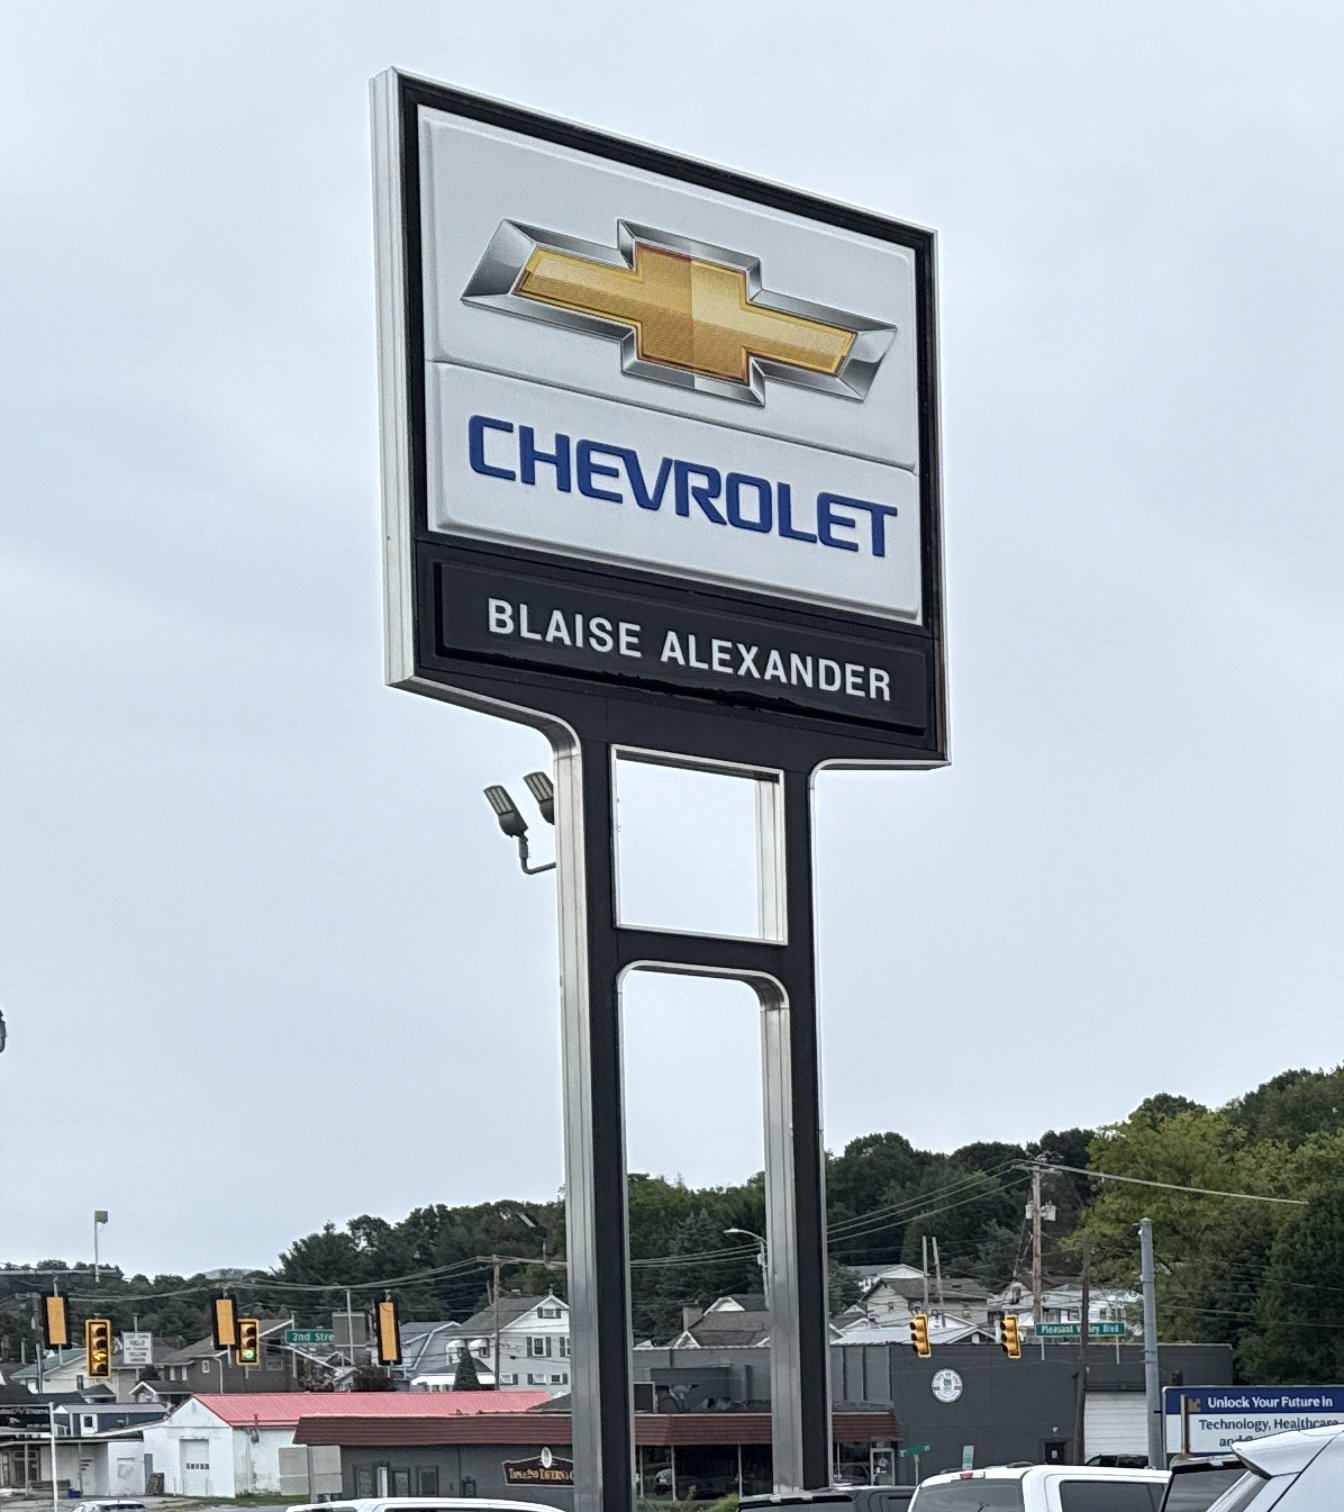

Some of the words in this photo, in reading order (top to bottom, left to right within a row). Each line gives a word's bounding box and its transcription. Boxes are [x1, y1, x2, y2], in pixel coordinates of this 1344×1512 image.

[468, 414, 898, 559] CHEVROLET
[487, 597, 642, 659] BLAISE
[660, 630, 891, 702] ALEXANDER
[292, 1331, 311, 1342] 2nd
[314, 1332, 335, 1342] Stre
[1041, 1324, 1073, 1334] Pleasant
[1075, 1325, 1100, 1336] Vley
[1103, 1324, 1119, 1334] Blvd
[1208, 1395, 1250, 1409] Unlock
[1252, 1396, 1279, 1409] Your
[1281, 1395, 1320, 1408] Future
[1198, 1417, 1272, 1432] Technology,
